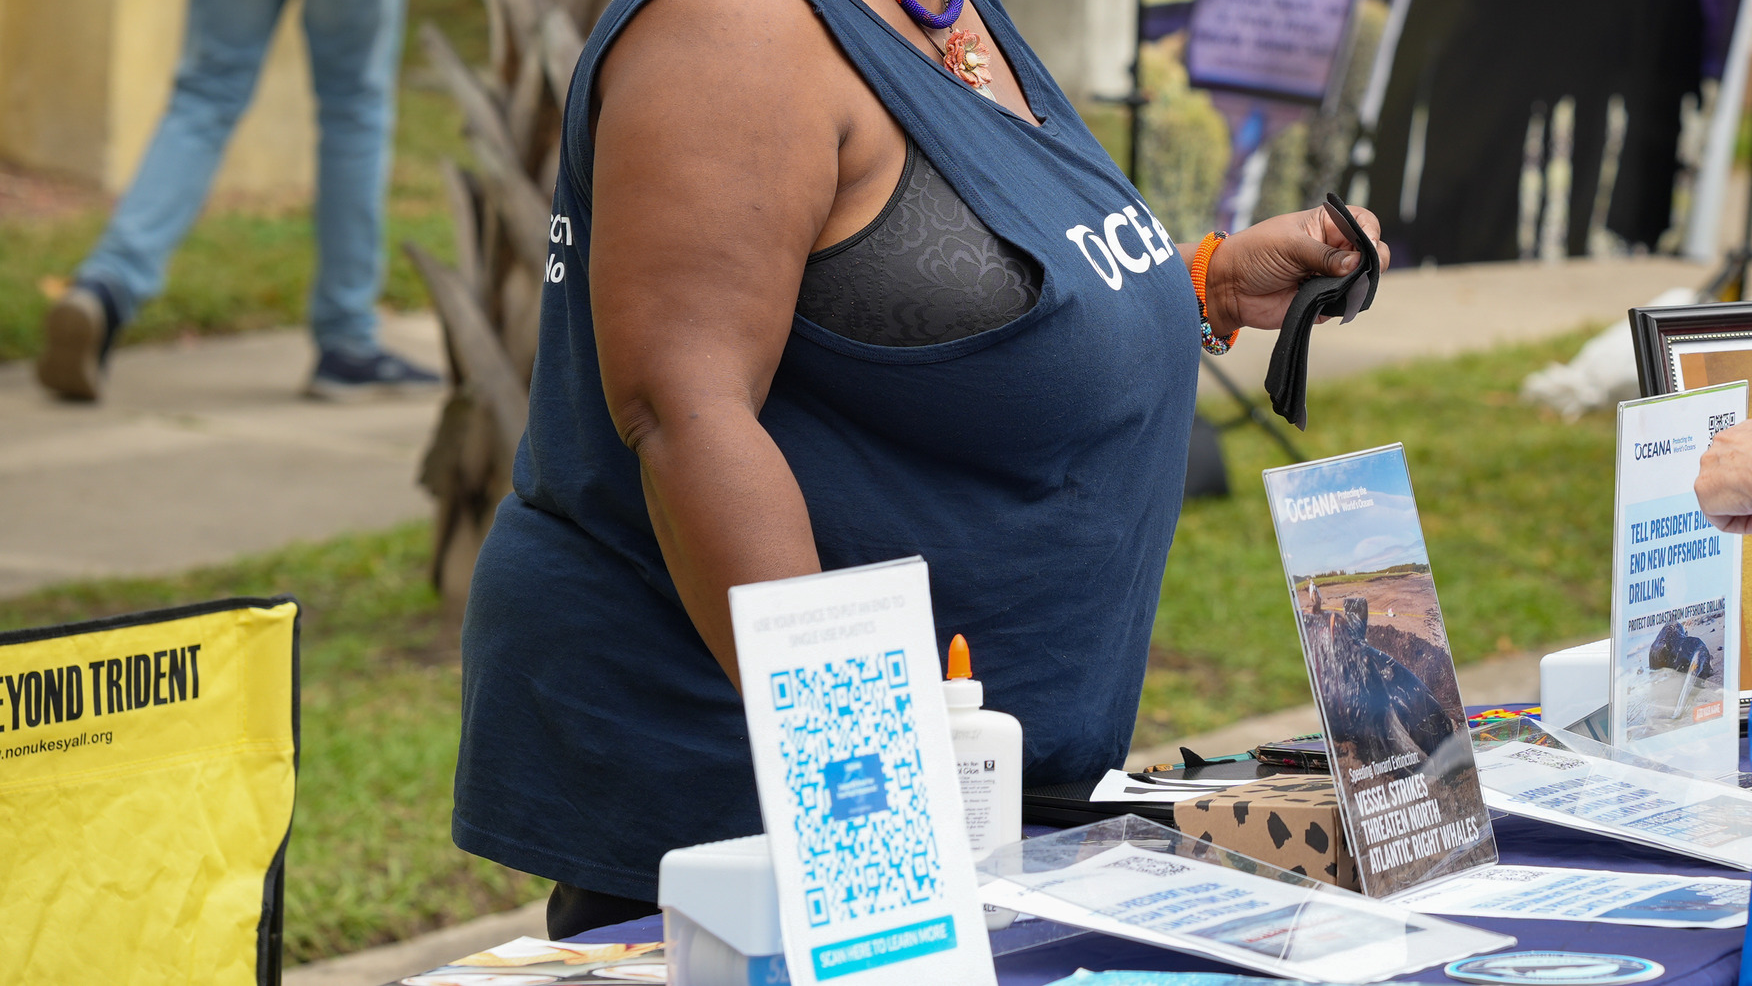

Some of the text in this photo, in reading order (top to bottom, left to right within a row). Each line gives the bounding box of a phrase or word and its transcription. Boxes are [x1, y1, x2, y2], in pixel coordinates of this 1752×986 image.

[1635, 439, 1672, 461] OCEANA
[1284, 493, 1341, 524] OCEANA
[1630, 521, 1649, 545] TELL
[1650, 511, 1694, 541] PRESIDENT
[1629, 535, 1721, 575] END NEW OFFSHORE OIL
[1628, 576, 1665, 605] DRILLING
[1627, 616, 1647, 633] PROTECT
[1646, 614, 1656, 628] OUR
[1684, 602, 1707, 619] OFFSHORE
[1706, 597, 1726, 613] DRILLING
[0, 644, 201, 733] YOND TRIDENT
[0, 731, 113, 761] .nonukesyall.org
[1349, 751, 1421, 783] Speeding Toward Extinction:
[1354, 772, 1429, 817] VESSEL STRIKES
[1360, 798, 1442, 846] THREATEN NORTH
[1369, 816, 1480, 875] ATLANTIC RIGHT WHALES
[819, 949, 847, 969] SCAN
[872, 939, 887, 954] TO
[888, 929, 918, 952] LEARN
[918, 922, 948, 945] MORE
